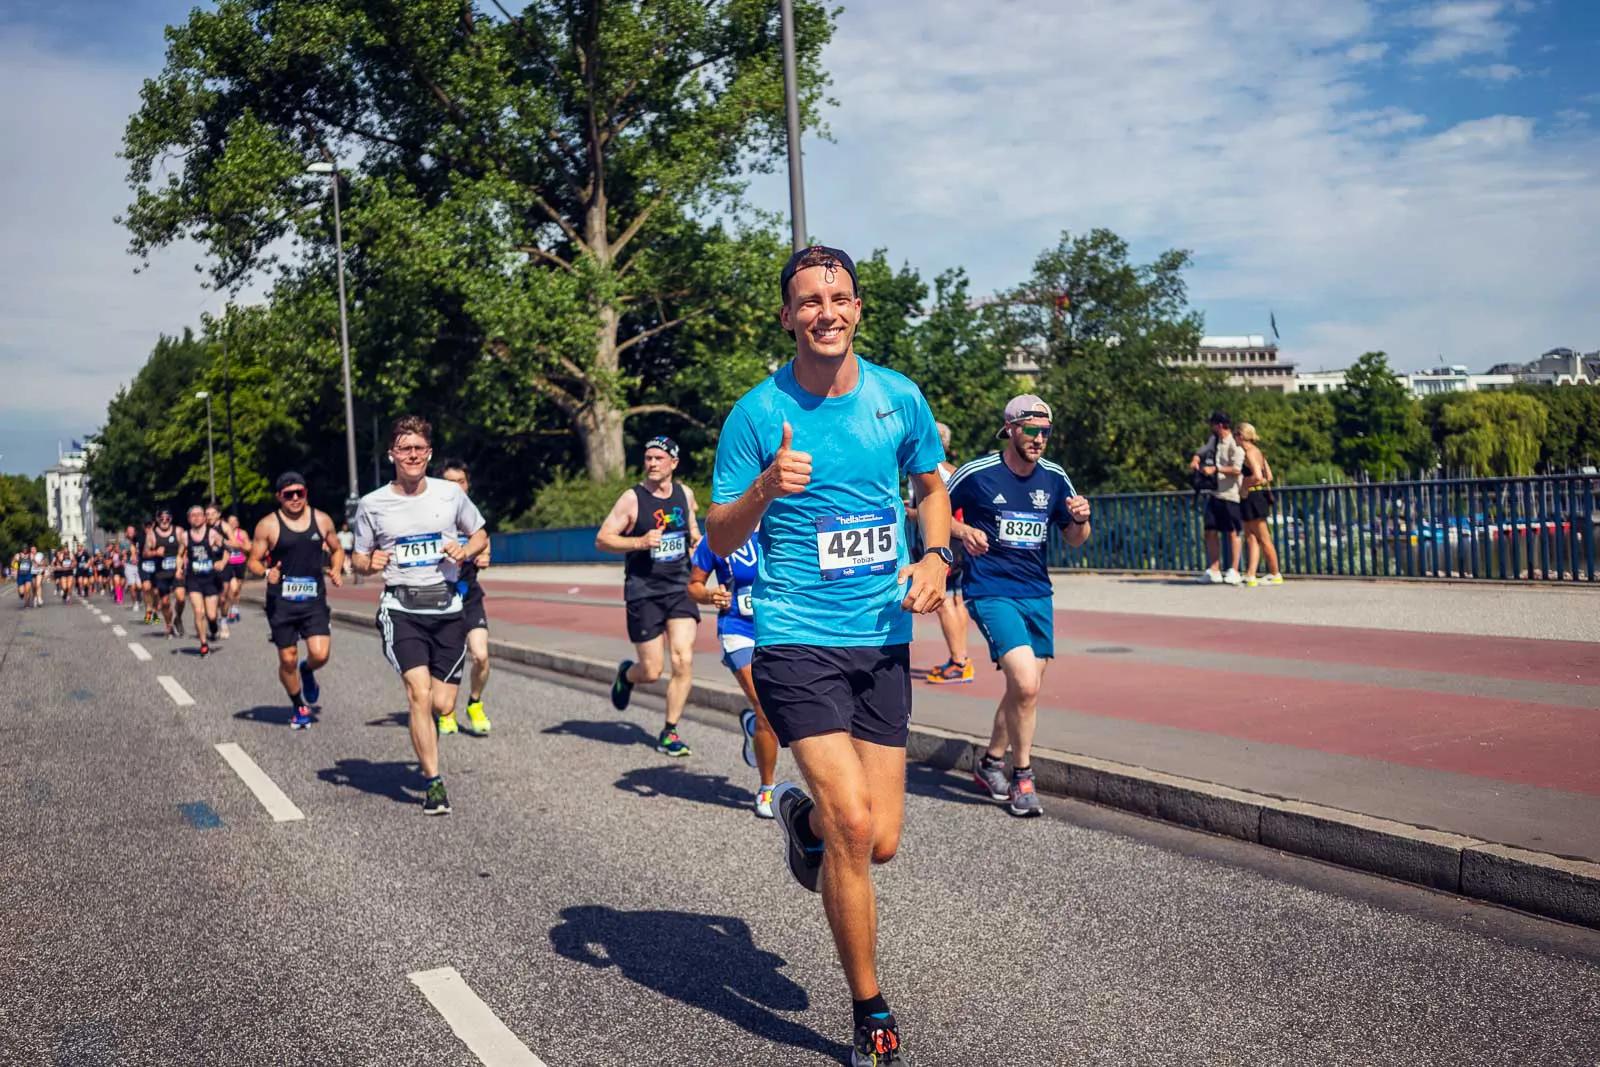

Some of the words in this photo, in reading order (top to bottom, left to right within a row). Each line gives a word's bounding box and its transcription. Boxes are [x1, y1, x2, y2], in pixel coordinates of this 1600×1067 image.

[1005, 521, 1042, 537] 8320
[401, 541, 437, 557] 7611
[828, 526, 891, 558] 4215
